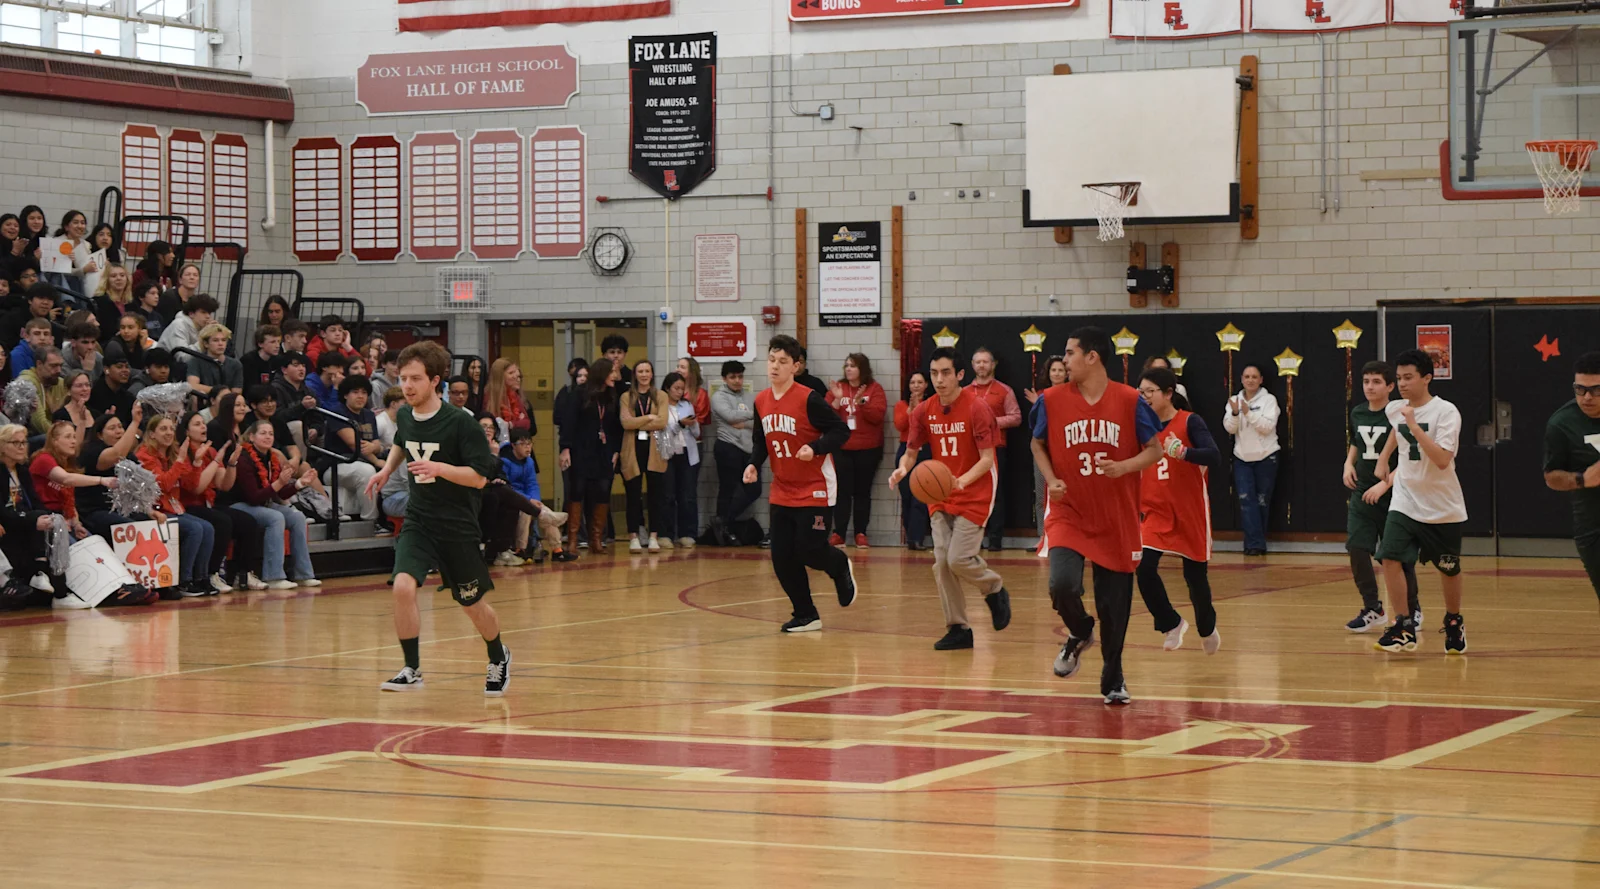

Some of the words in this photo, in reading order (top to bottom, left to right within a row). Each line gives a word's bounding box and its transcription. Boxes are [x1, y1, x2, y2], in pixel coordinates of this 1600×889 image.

[634, 42, 665, 62] FOX
[669, 40, 711, 59] LANE
[370, 66, 401, 78] FOX
[406, 64, 446, 77] LANE
[451, 62, 492, 75] HIGH
[497, 59, 564, 73] SCHOOL
[652, 63, 693, 73] WRESTLING
[406, 82, 450, 98] HALL
[454, 81, 477, 95] OF
[480, 79, 525, 94] FAME
[648, 77, 666, 86] HALL
[667, 76, 677, 85] OF
[678, 75, 697, 85] FAME
[645, 98, 658, 107] JOE
[659, 98, 687, 108] AMUSO,
[688, 97, 699, 106] SR.
[773, 414, 797, 436] LANE
[930, 423, 944, 435] FOX
[944, 421, 966, 434] LANE
[1064, 419, 1089, 449] FOX
[1090, 418, 1121, 448] LANE
[772, 440, 792, 458] 21
[940, 436, 958, 456] 17
[1357, 425, 1387, 460] Y
[1398, 422, 1429, 460] Y
[405, 440, 440, 484] Y
[1078, 452, 1108, 476] 35
[113, 524, 136, 543] GO
